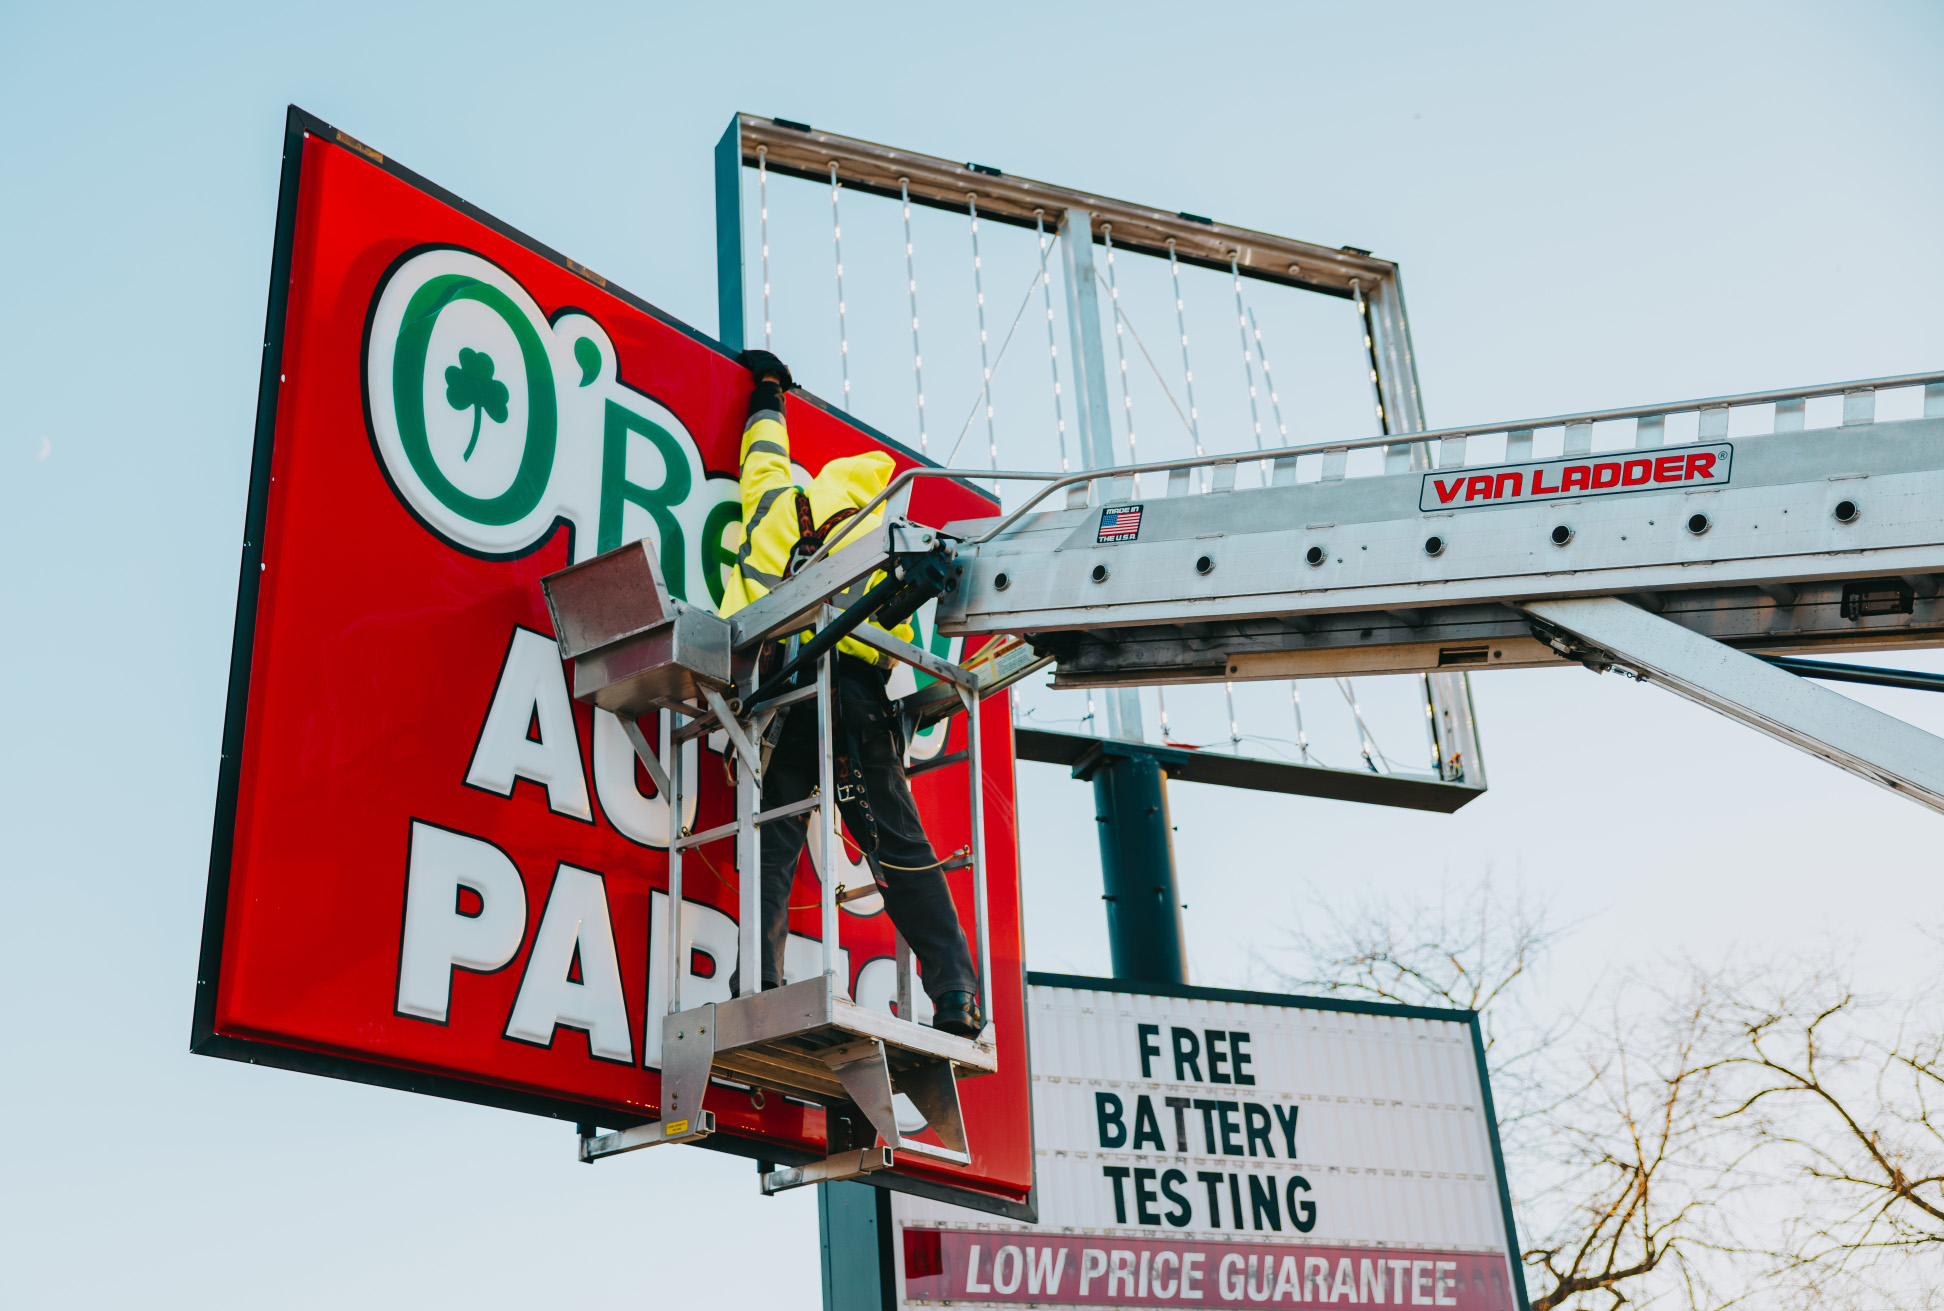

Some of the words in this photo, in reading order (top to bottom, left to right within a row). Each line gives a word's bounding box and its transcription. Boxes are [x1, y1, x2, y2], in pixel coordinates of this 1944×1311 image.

[1433, 471, 1524, 504] VAN
[1137, 1023, 1256, 1086] FREE
[1095, 1091, 1299, 1159] BATTERY
[1102, 1165, 1317, 1233] TESTING
[965, 1244, 1068, 1294] LOW
[1079, 1248, 1203, 1300] PRICE
[1218, 1252, 1457, 1305] GUARANTEE
